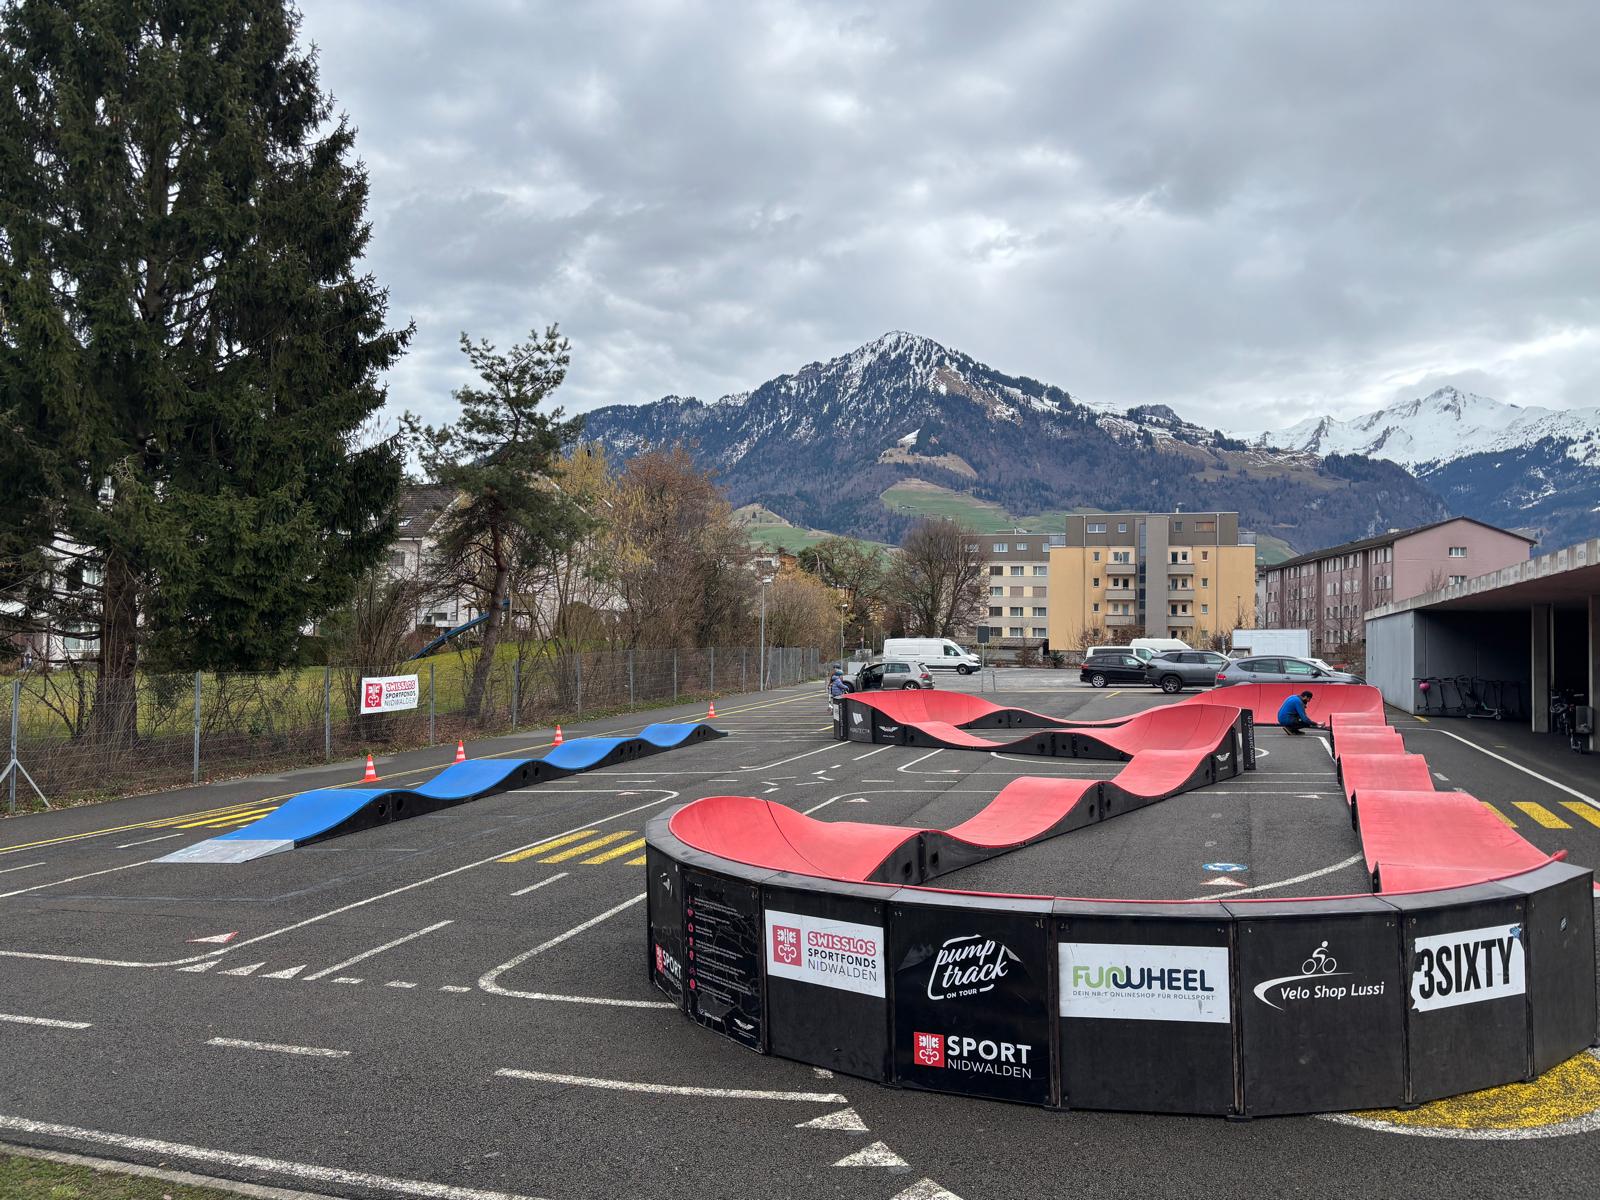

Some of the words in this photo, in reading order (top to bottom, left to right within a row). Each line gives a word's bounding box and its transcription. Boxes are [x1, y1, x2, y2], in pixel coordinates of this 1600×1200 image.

[385, 680, 415, 692] SWISSLOS
[385, 690, 416, 700] SPORTFONDS
[384, 698, 416, 706] NIDWALDEN
[807, 931, 876, 956] SWISSLOS
[937, 940, 996, 966] pump
[662, 950, 682, 980] SPORT
[808, 948, 876, 969] SPORTFONDS
[808, 958, 876, 982] NIDWALDEN
[942, 945, 1008, 988] track
[1415, 936, 1514, 1000] 3SIXTY
[1072, 966, 1214, 992] FUNWHEEL
[1280, 986, 1310, 1000] Velo
[1314, 984, 1346, 1000] Shop
[1350, 982, 1385, 997] Lussi
[947, 1036, 1032, 1064] SPORT
[948, 1059, 1032, 1080] NIDWALDEN
